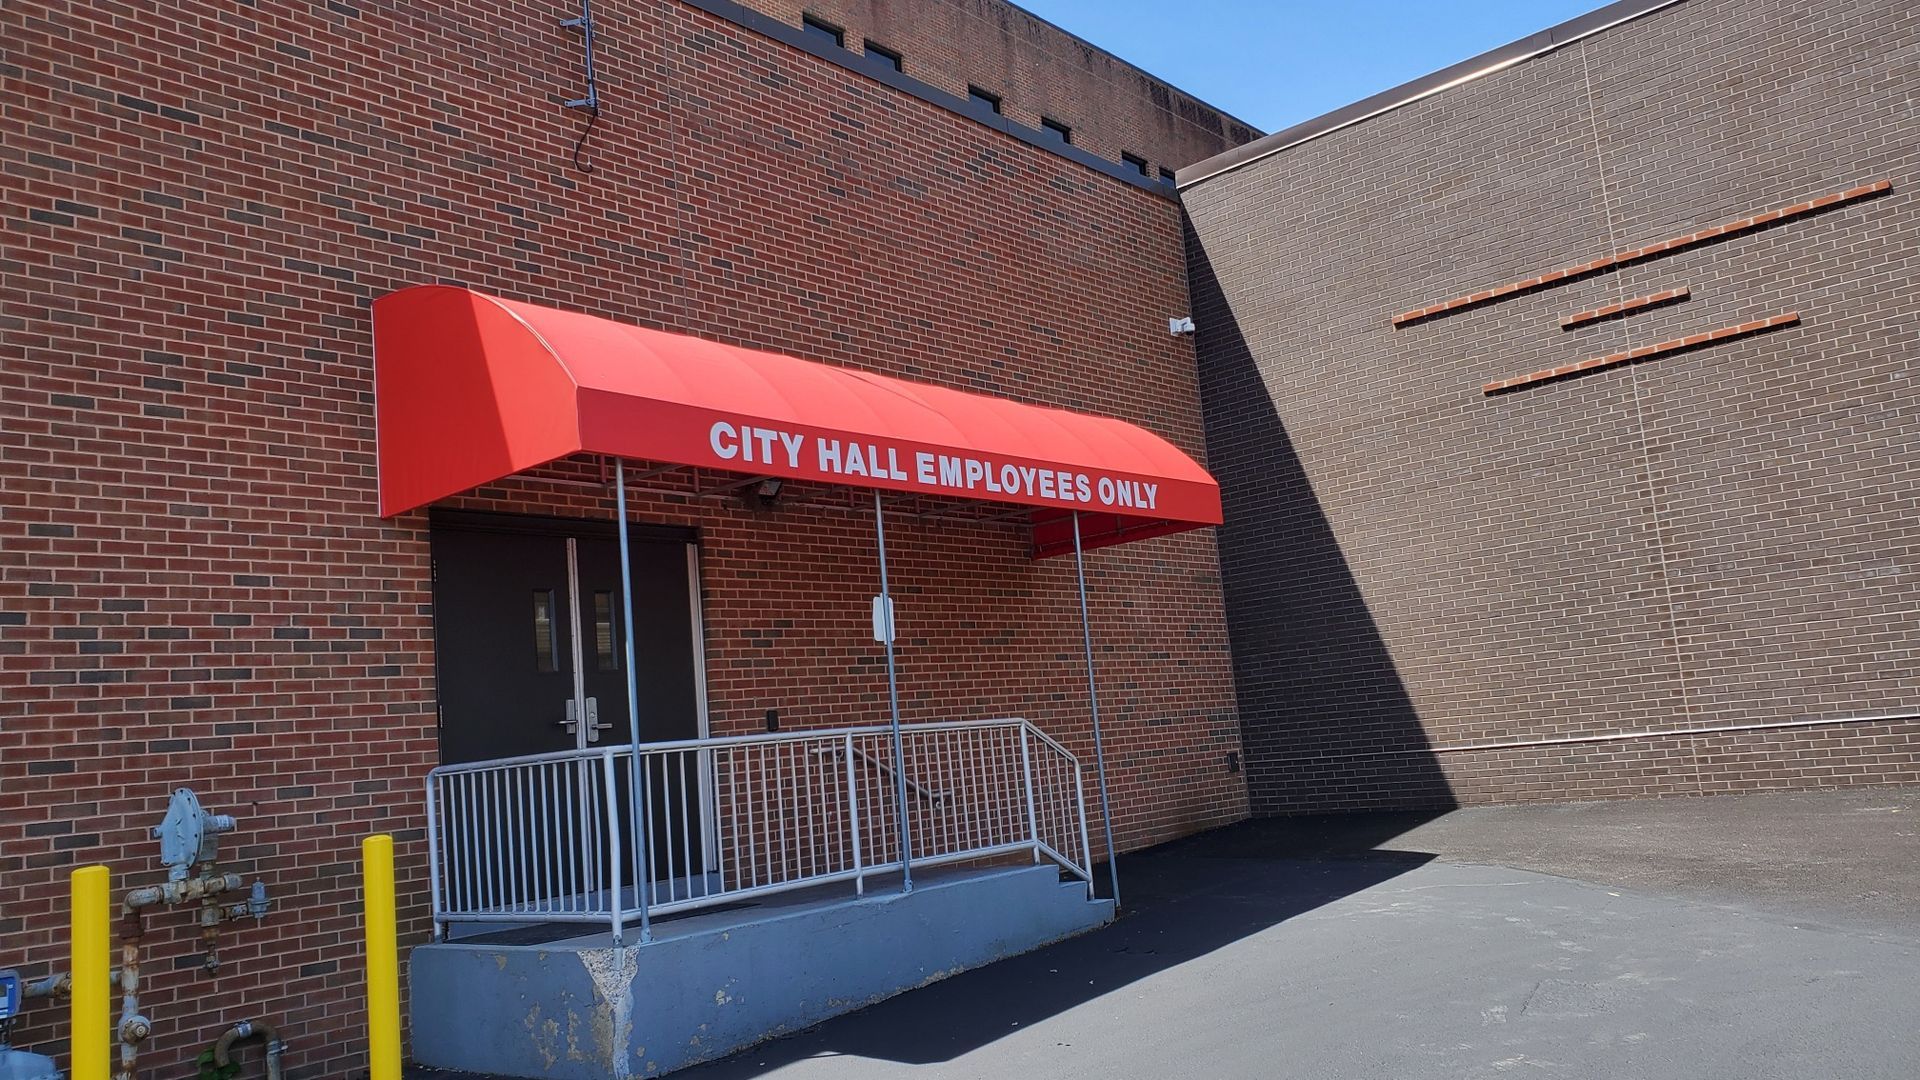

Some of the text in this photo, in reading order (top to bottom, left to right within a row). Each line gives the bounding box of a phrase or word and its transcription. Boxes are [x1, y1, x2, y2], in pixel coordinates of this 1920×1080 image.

[709, 421, 1157, 509] CITY HALL EMPLOYEES ONLY
